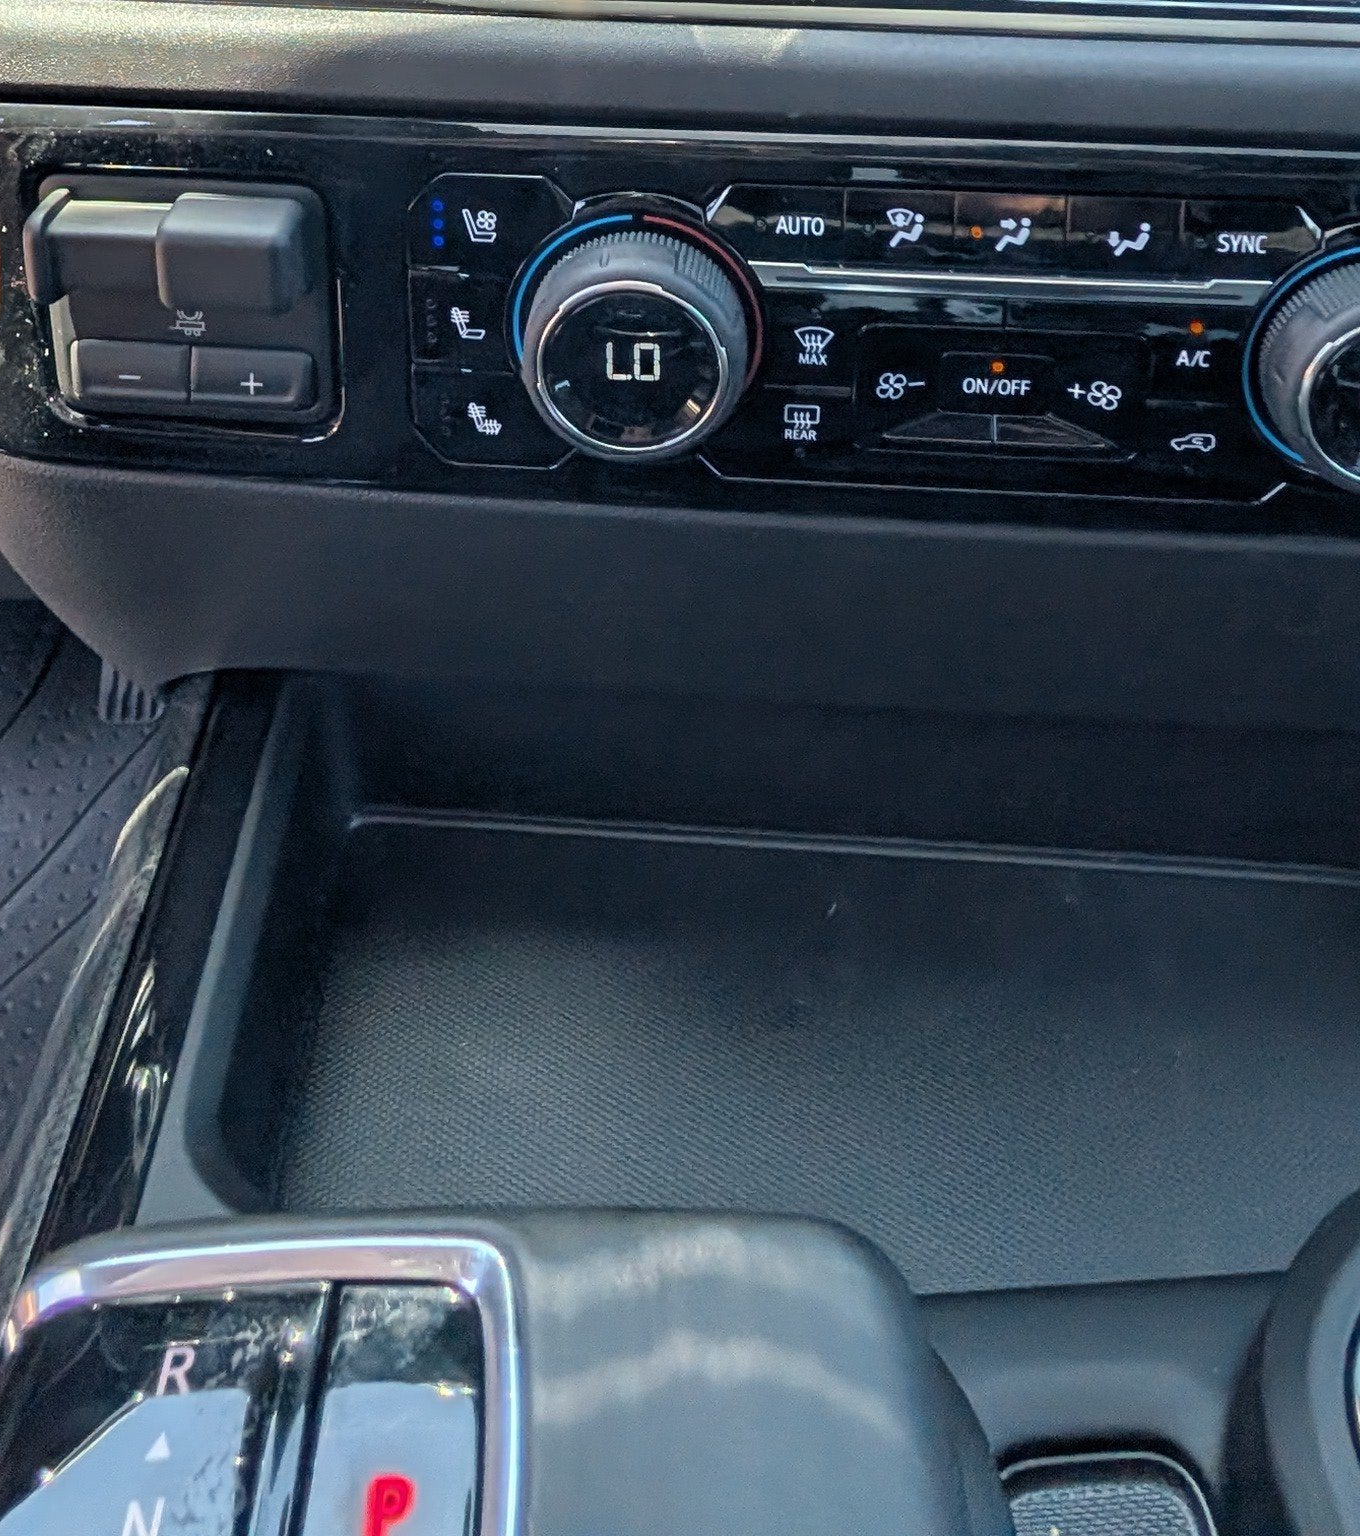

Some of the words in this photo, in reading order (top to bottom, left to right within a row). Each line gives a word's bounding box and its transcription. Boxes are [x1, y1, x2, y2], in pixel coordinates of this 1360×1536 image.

[775, 215, 825, 237] AUTO
[1216, 233, 1268, 255] SYNC
[605, 341, 661, 382] LO
[798, 353, 829, 366] MAX
[1175, 350, 1211, 368] A/C
[961, 377, 1032, 397] ON/OFF
[784, 427, 817, 442] REAR
[155, 1346, 196, 1397] R
[362, 1473, 416, 1536] P
[120, 1497, 166, 1536] N
